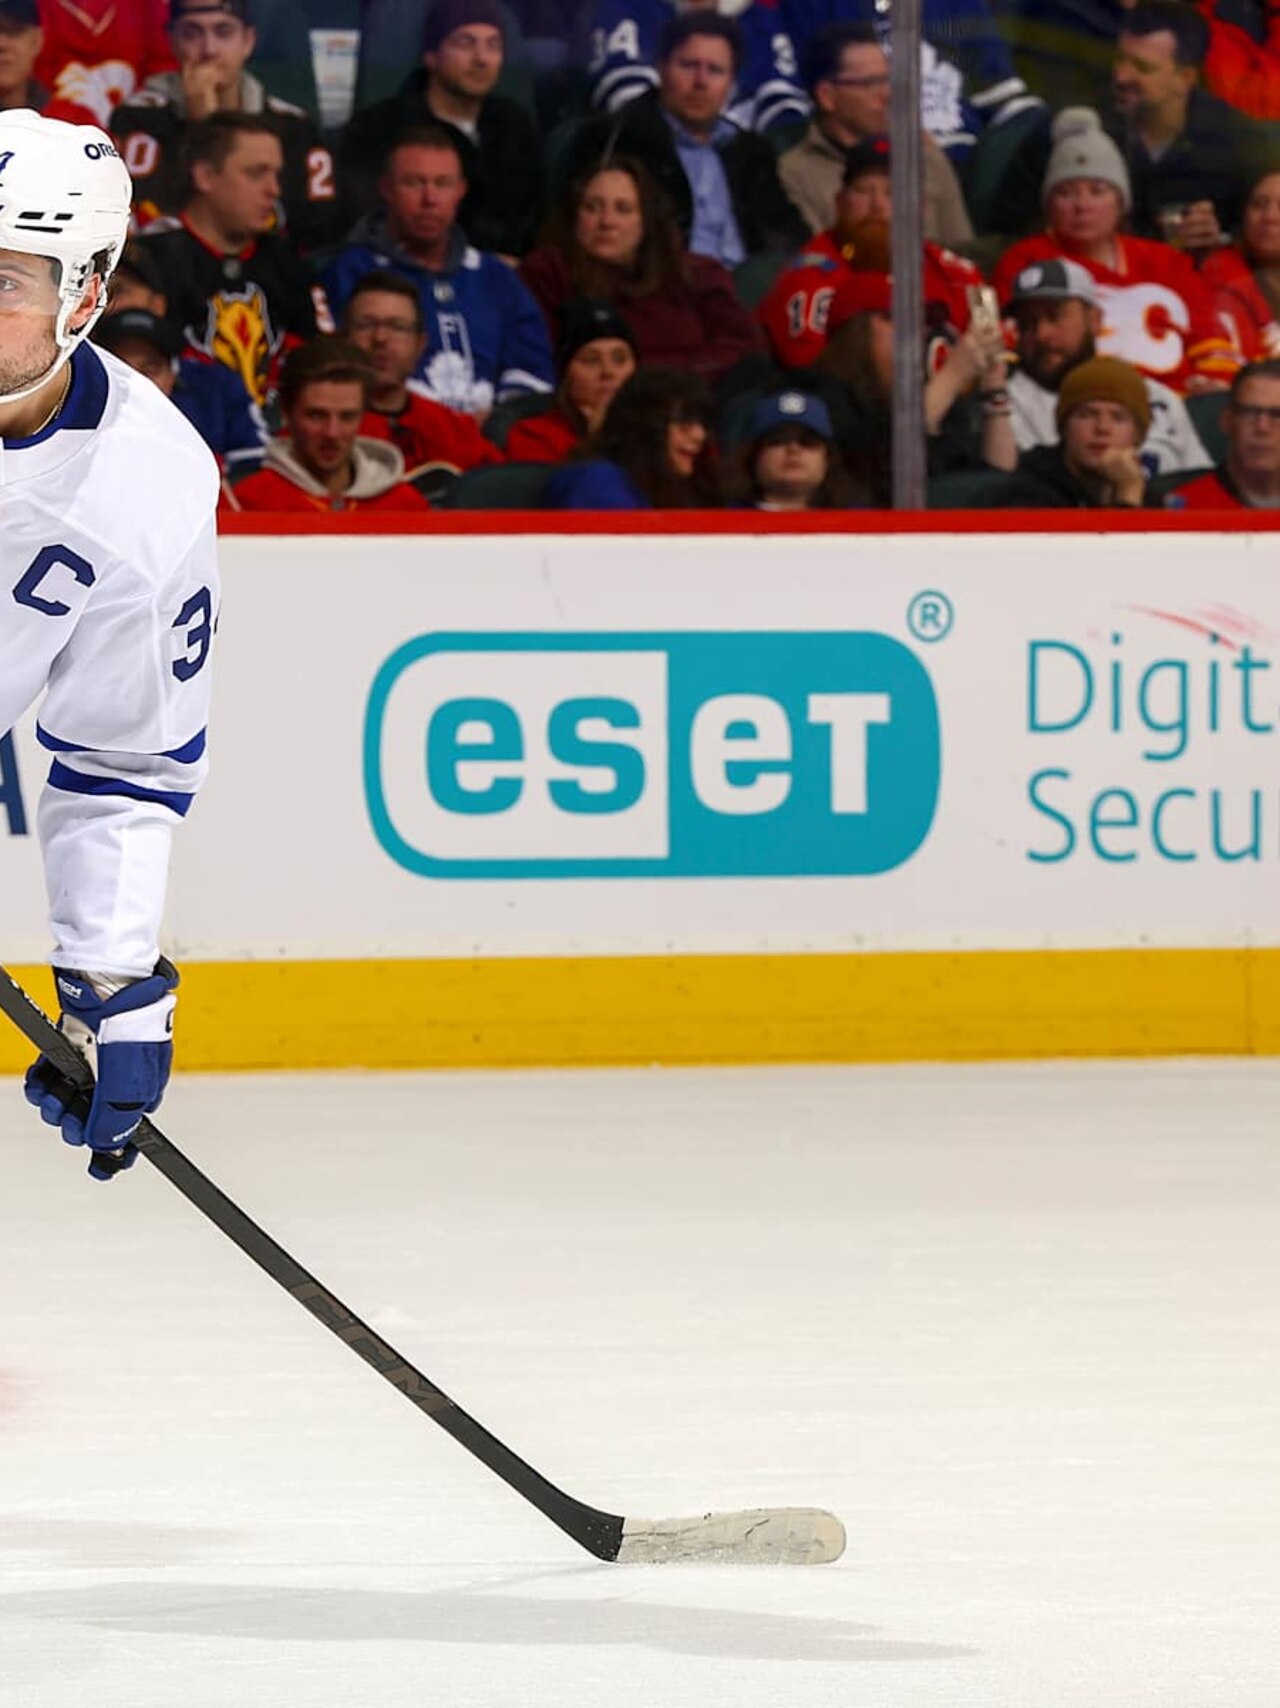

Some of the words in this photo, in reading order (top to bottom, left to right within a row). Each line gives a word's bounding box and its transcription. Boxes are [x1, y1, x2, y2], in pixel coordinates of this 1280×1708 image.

[306, 149, 335, 199] 2
[12, 543, 97, 618] C
[170, 586, 220, 683] 3
[1025, 767, 1280, 865] Secu
